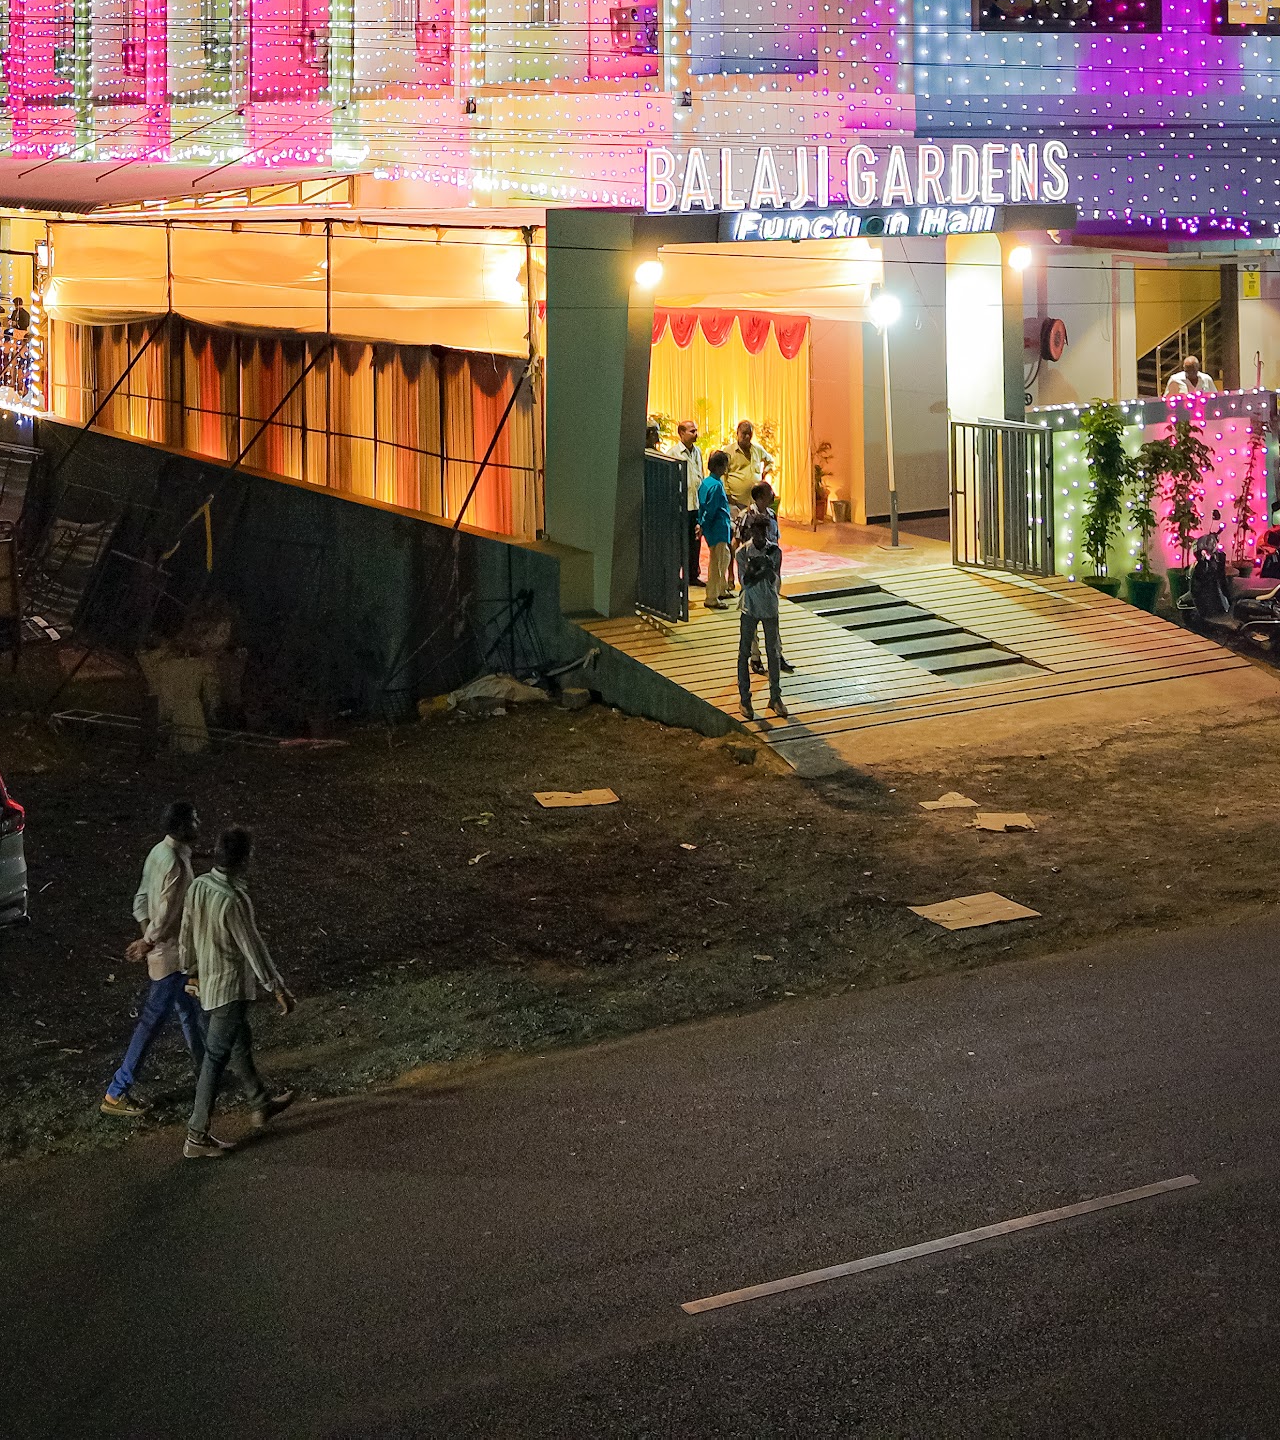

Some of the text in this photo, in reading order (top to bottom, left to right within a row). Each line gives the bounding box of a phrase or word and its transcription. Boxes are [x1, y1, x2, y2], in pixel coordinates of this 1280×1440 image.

[645, 140, 1069, 213] BALAJI GARDENS
[733, 206, 995, 241] Function Hall
